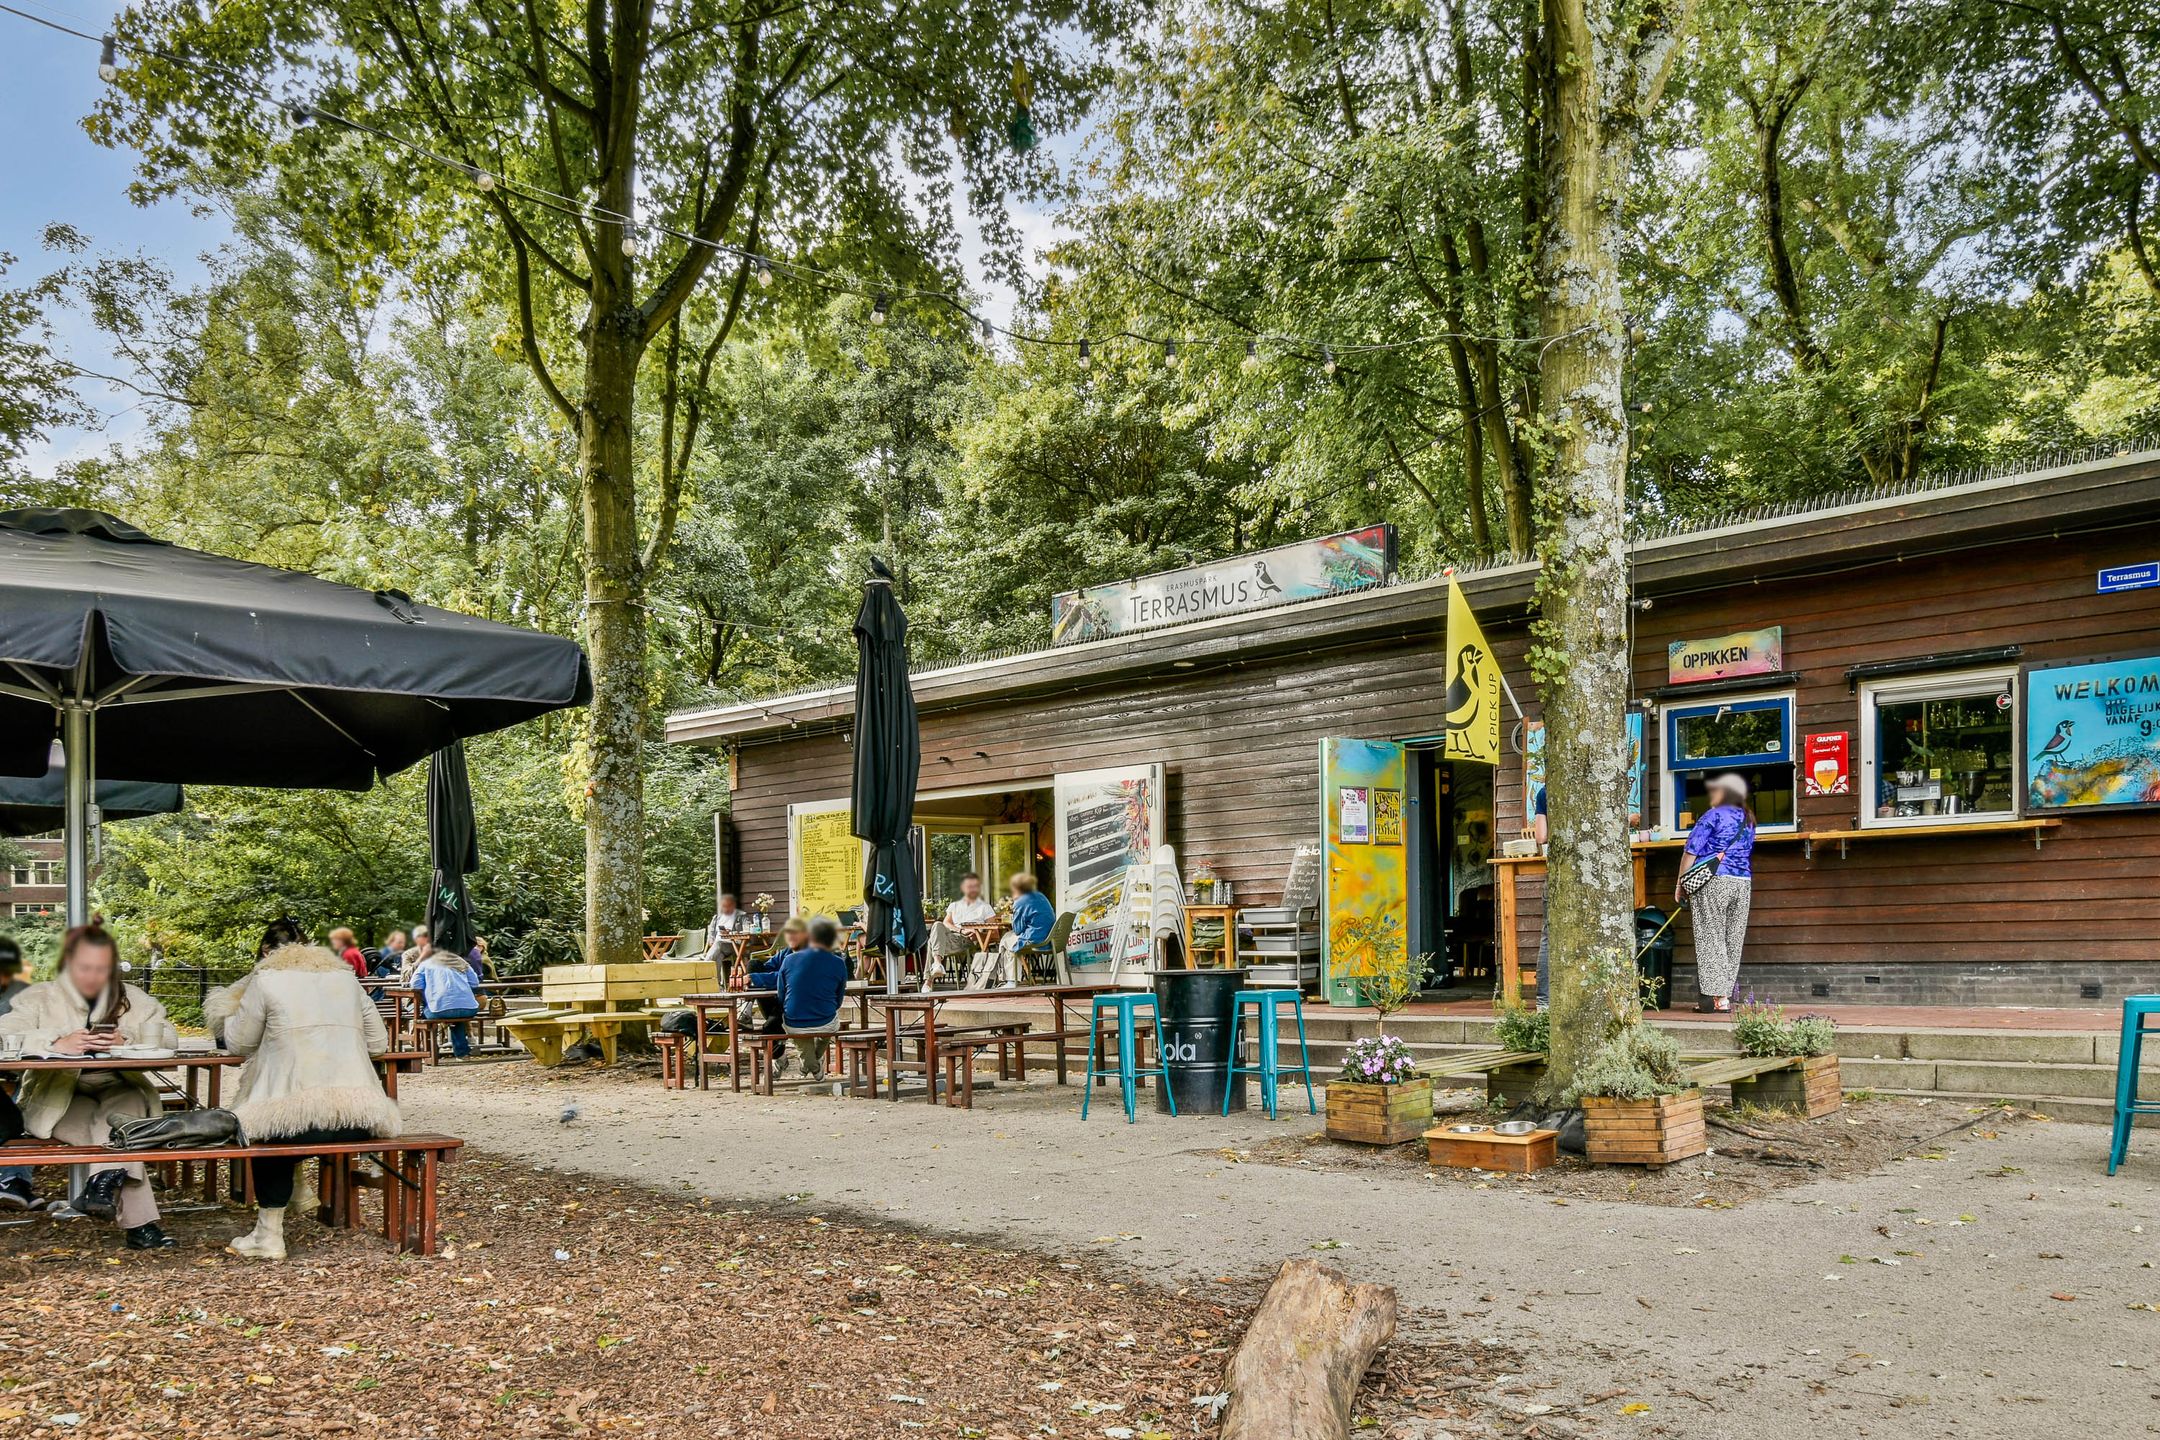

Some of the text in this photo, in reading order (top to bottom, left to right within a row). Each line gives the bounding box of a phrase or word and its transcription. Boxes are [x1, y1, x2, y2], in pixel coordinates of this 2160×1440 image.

[1166, 575, 1217, 592] ERASMUSPARK
[2106, 570, 2151, 582] Terrasmus
[1130, 580, 1248, 624] TERRASMUS
[1683, 646, 1748, 668] OPPIKKEN
[1489, 673, 1497, 736] PICK UP
[2106, 714, 2141, 726] VANAF
[1067, 928, 1109, 947] BESTELLEN
[1094, 942, 1109, 955] AAN
